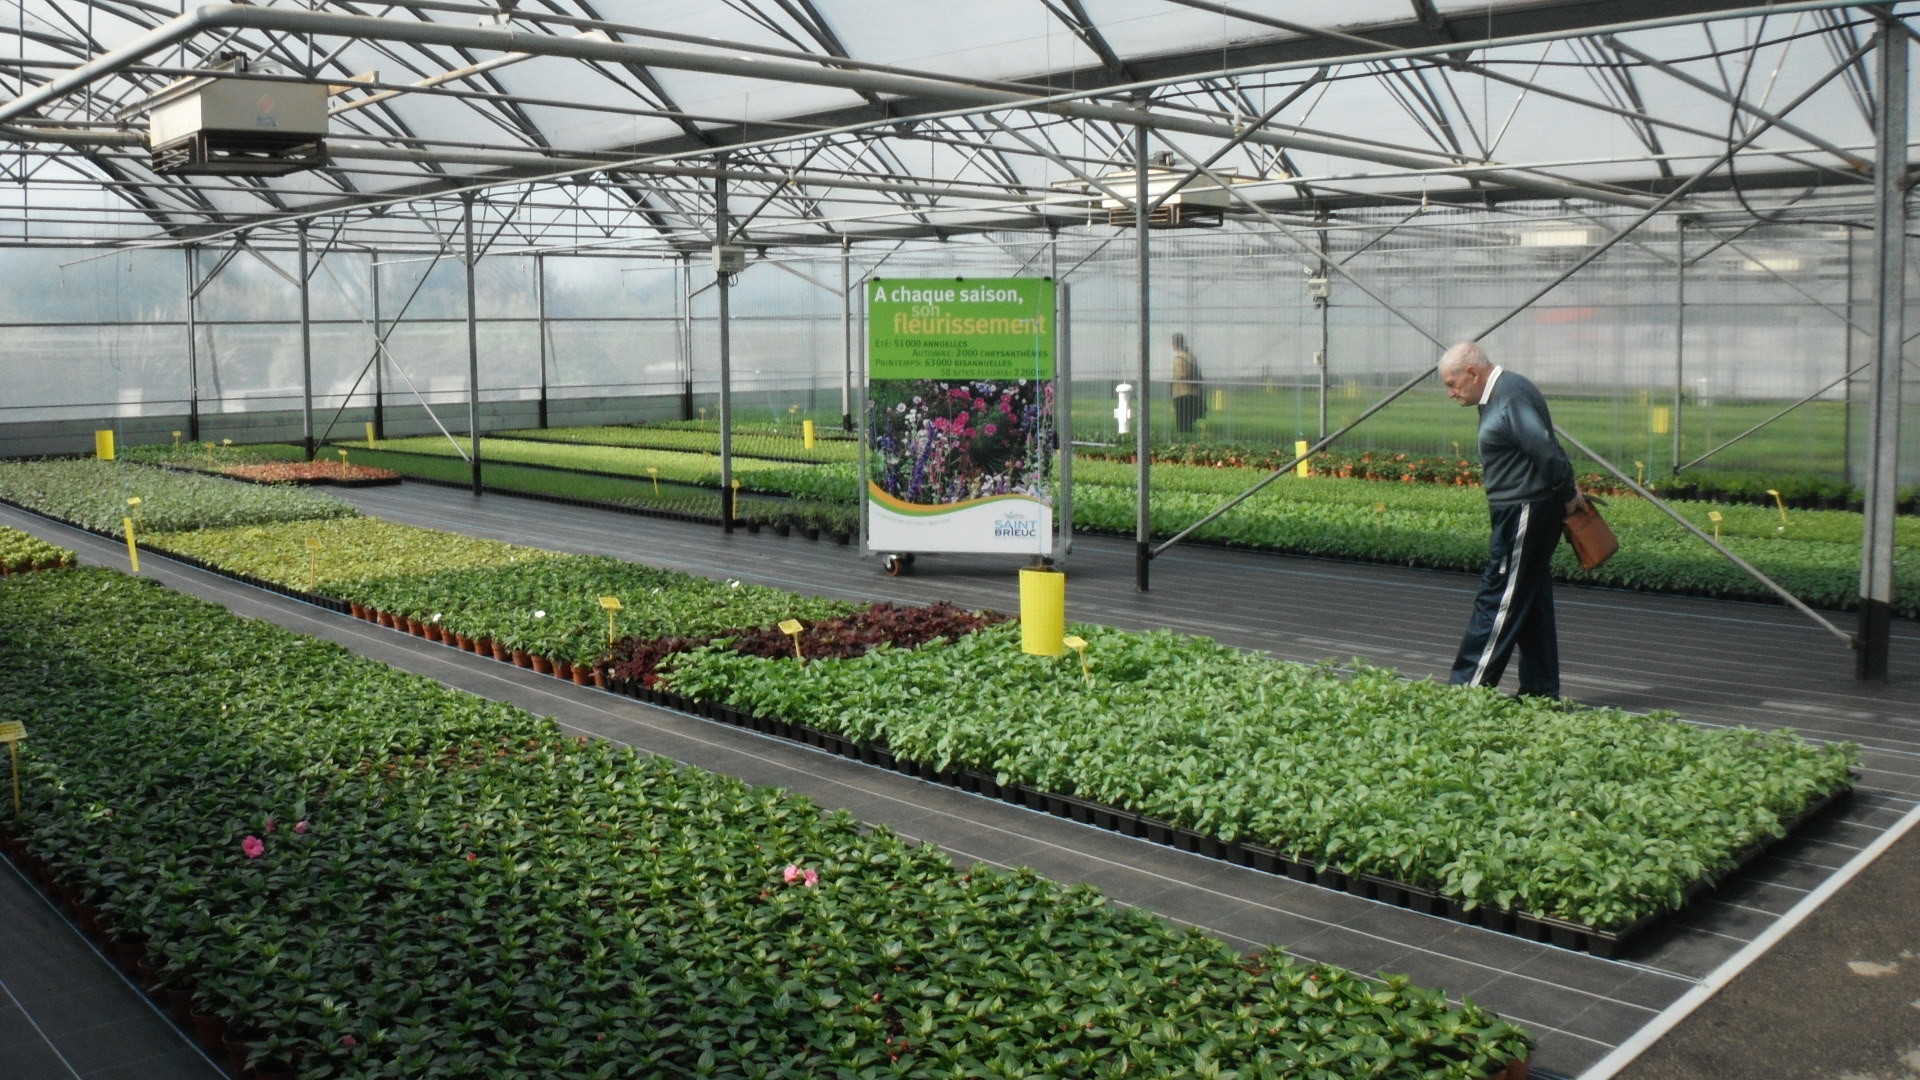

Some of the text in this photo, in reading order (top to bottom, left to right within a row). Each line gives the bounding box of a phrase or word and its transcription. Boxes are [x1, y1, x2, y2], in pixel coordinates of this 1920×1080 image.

[874, 285, 1023, 306] A chaque saison,
[911, 305, 940, 318] son
[894, 312, 1047, 335] fleurissement
[922, 340, 968, 348] ANNUELLES
[954, 359, 1012, 367] BISANNUELLES
[995, 519, 1038, 530] SAINT
[995, 527, 1037, 537] BRIEUC
